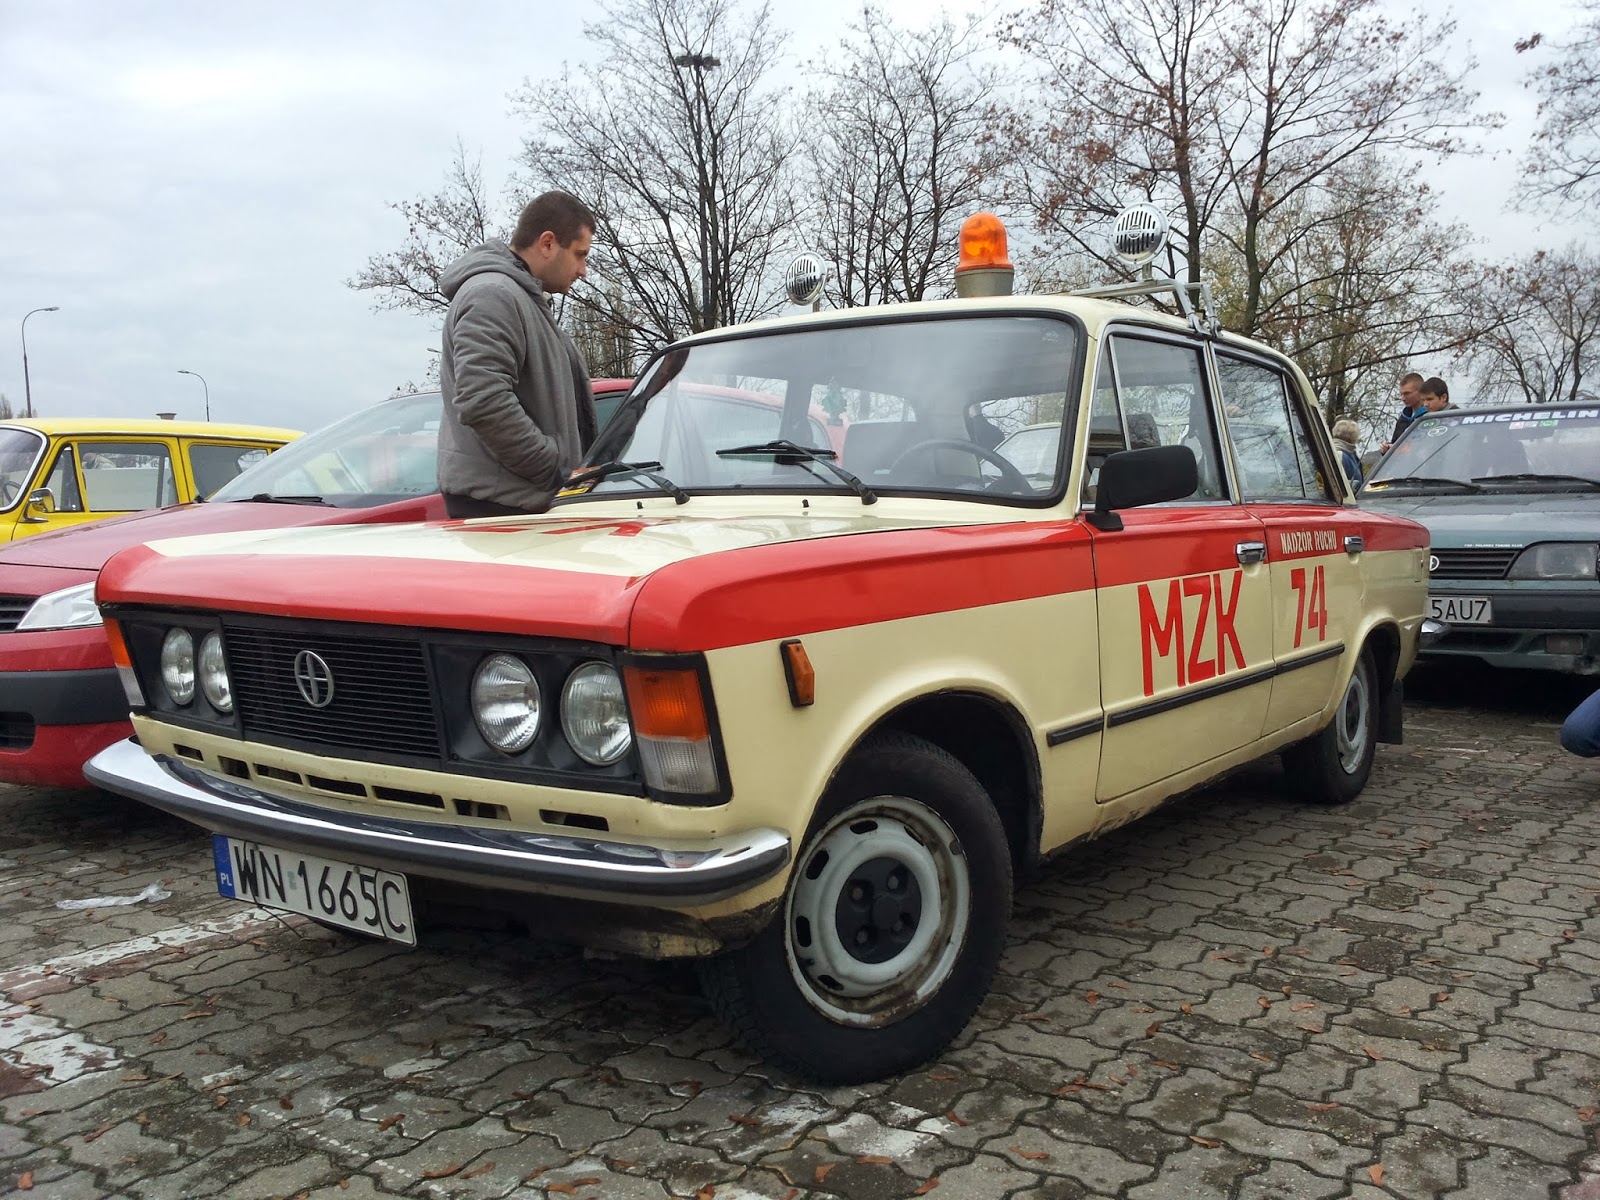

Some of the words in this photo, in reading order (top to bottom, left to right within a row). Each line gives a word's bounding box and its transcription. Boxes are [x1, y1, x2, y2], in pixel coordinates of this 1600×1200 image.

[1461, 409, 1599, 425] MICHELIN
[1313, 530, 1338, 551] RUCHU
[1290, 565, 1328, 649] 74
[1431, 599, 1488, 621] 5AU7
[1137, 569, 1247, 698] MZK
[220, 872, 233, 887] PL
[234, 845, 287, 904] WN
[297, 860, 407, 934] 1665C
